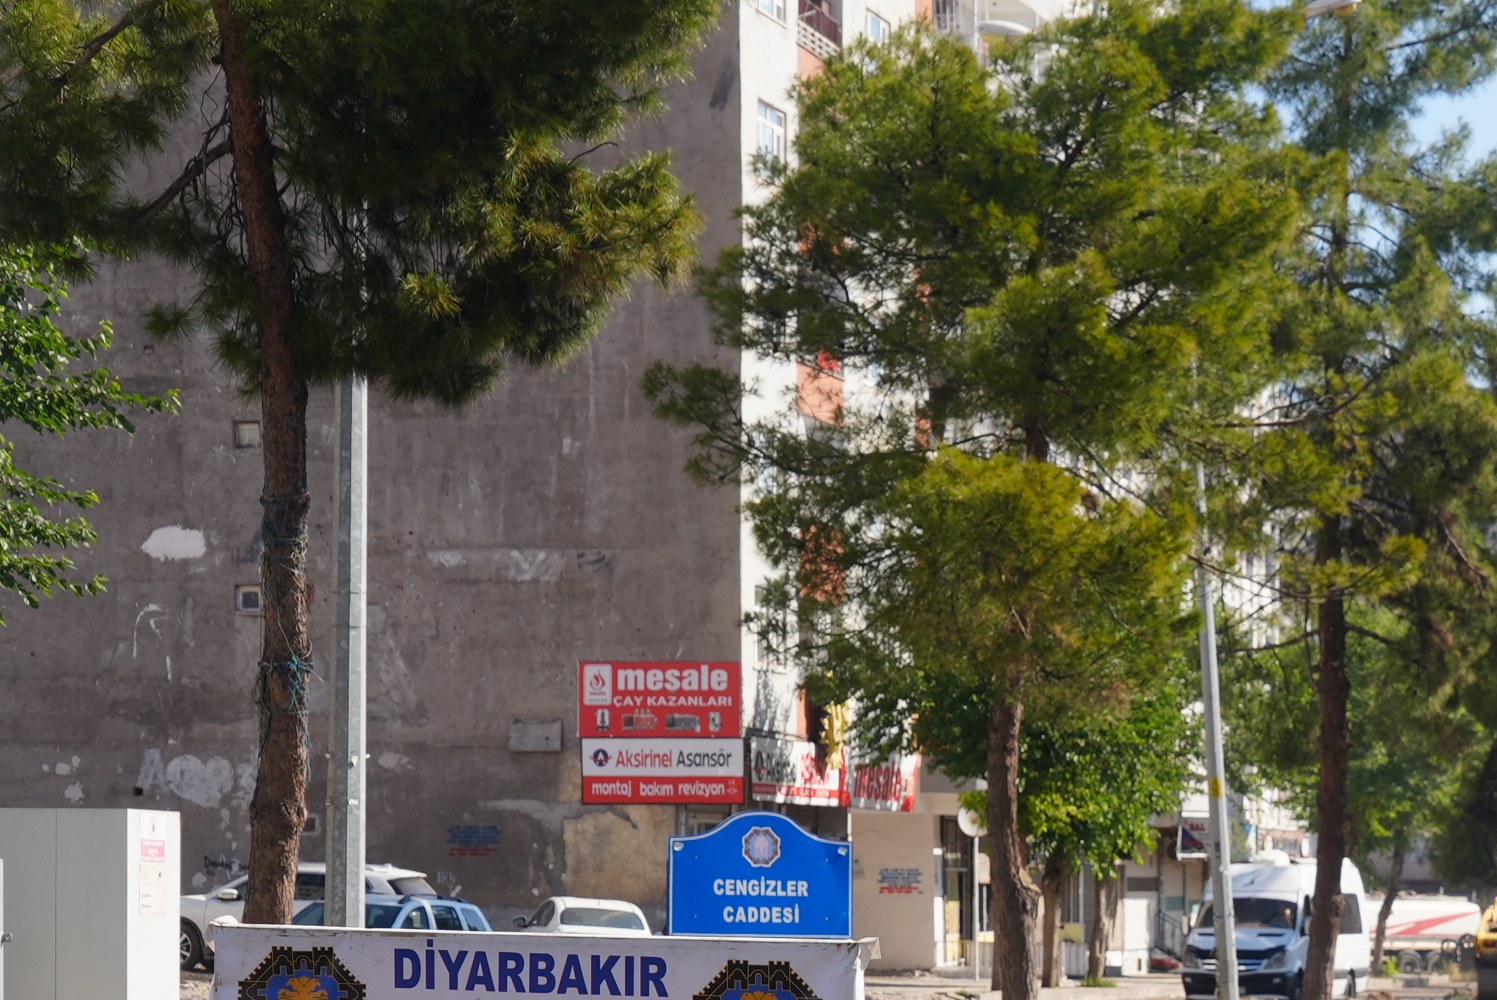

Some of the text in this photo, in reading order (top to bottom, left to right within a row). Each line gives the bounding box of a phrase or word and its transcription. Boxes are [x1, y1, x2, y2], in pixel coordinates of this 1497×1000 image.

[613, 696, 732, 707] ÇAY KAZANLARI
[677, 748, 732, 767] Asansör
[592, 780, 632, 797] montaj
[640, 782, 673, 796] bakım
[678, 780, 725, 797] revizyon
[713, 876, 809, 897] CENGİZLER
[723, 903, 800, 924] CADDESİ
[393, 938, 669, 998] DİYARBAKIR
